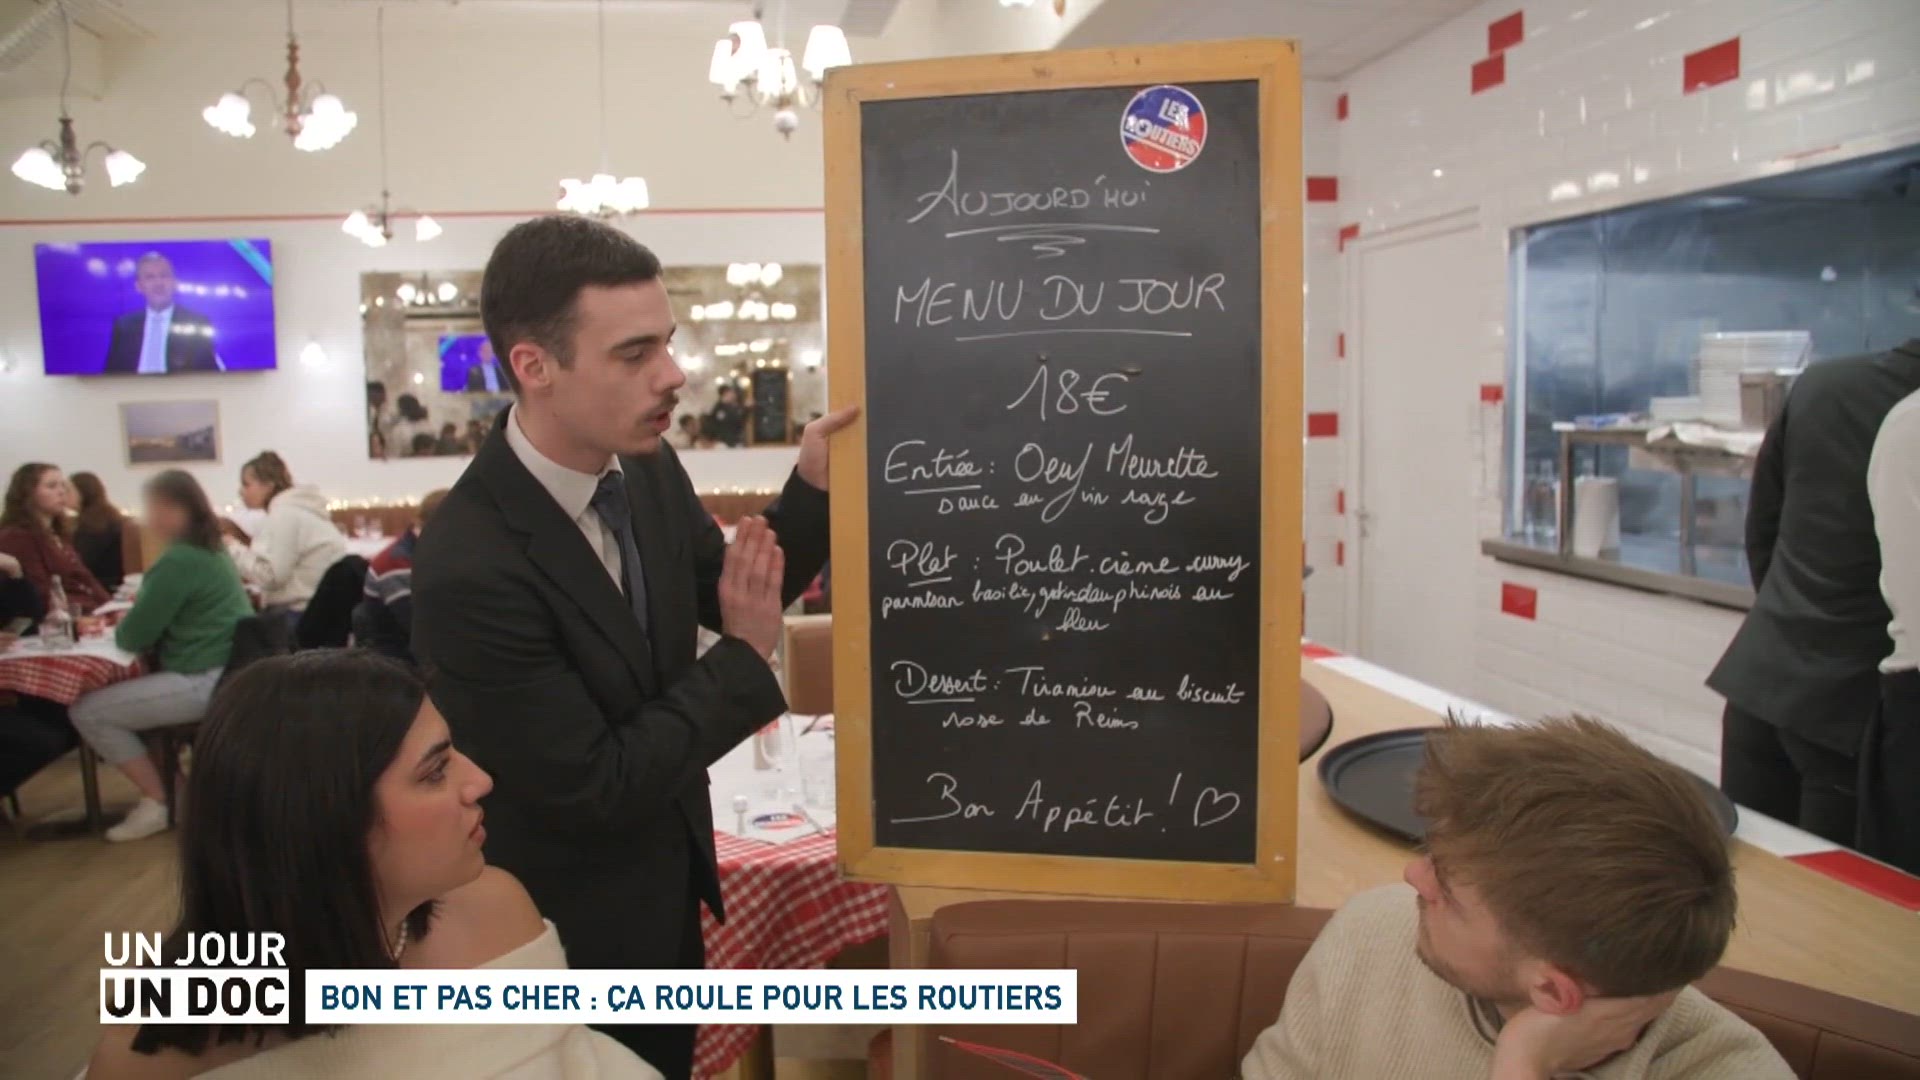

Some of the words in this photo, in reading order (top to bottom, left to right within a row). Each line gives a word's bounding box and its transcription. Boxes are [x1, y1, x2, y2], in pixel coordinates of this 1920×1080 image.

[894, 277, 1024, 328] MENU
[1040, 275, 1106, 321] DU
[1118, 273, 1226, 314] JOUR
[1007, 364, 1130, 422] 18€
[890, 772, 996, 823] Bon
